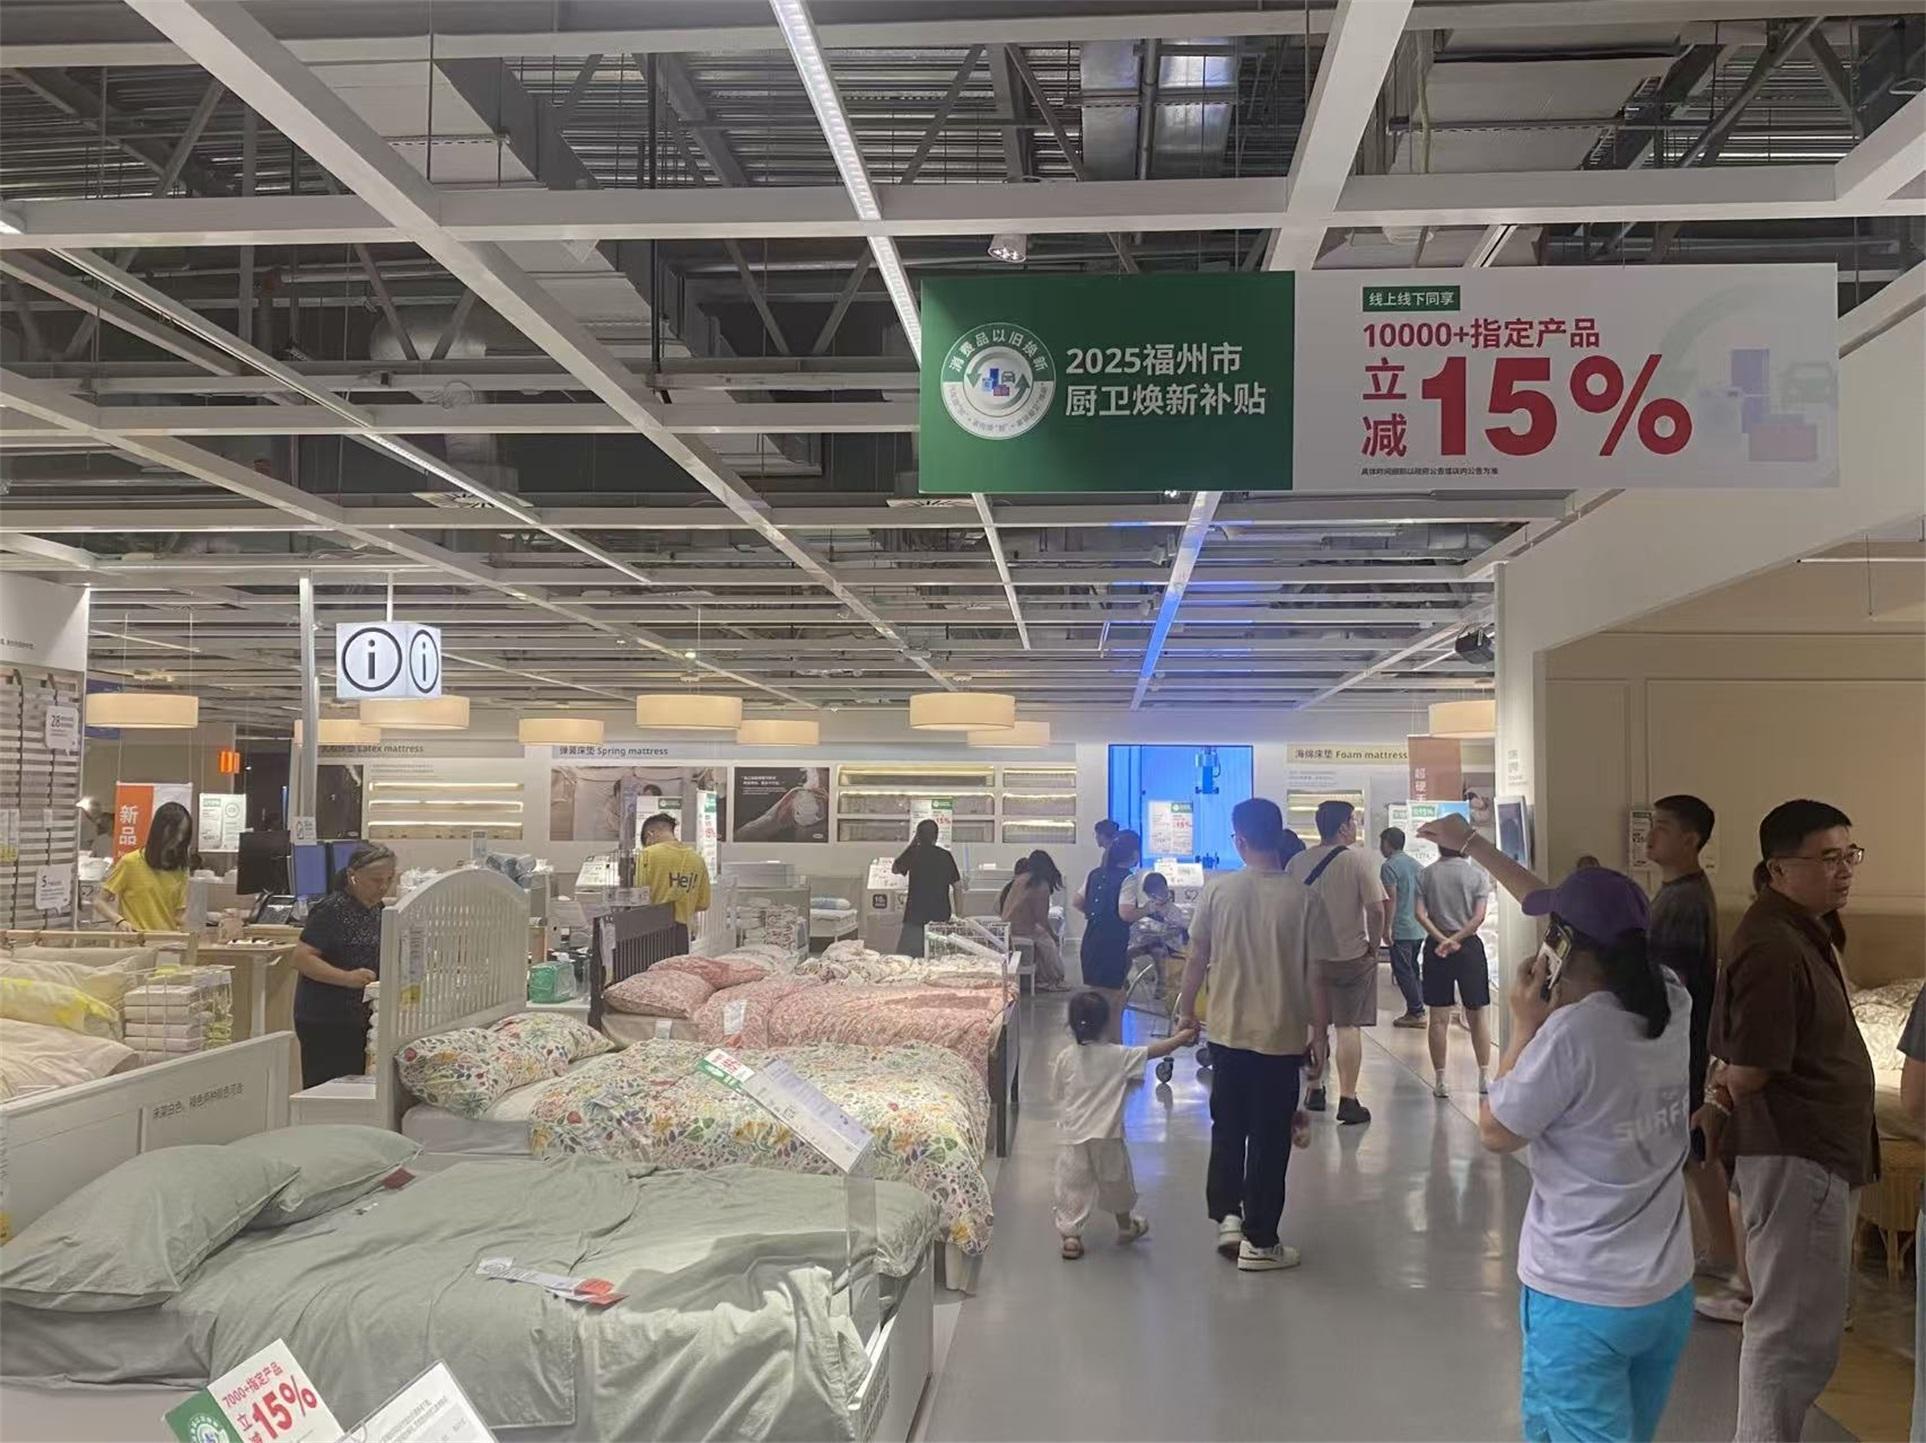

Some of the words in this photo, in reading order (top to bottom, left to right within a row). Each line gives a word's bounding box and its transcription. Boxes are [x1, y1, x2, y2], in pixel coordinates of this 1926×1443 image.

[1368, 291, 1456, 307] 线上线下同享
[1362, 318, 1601, 349] 10000+指定产品
[948, 328, 1049, 373] 消费品以旧换新
[1065, 342, 1243, 375] 2025福州市
[1065, 382, 1267, 417] 厨卫焕新补贴
[1421, 353, 1693, 457] 15%
[384, 743, 424, 753] mattress
[597, 746, 626, 757] Spring
[628, 746, 669, 755] mattress
[1295, 749, 1333, 759] 海绵床垫
[1335, 750, 1362, 759] Foam
[1364, 750, 1408, 759] mattress
[119, 804, 139, 846] 新品
[668, 871, 698, 893] Hej!
[221, 1361, 284, 1409] 7000+指定产品
[252, 1374, 319, 1440] 15%
